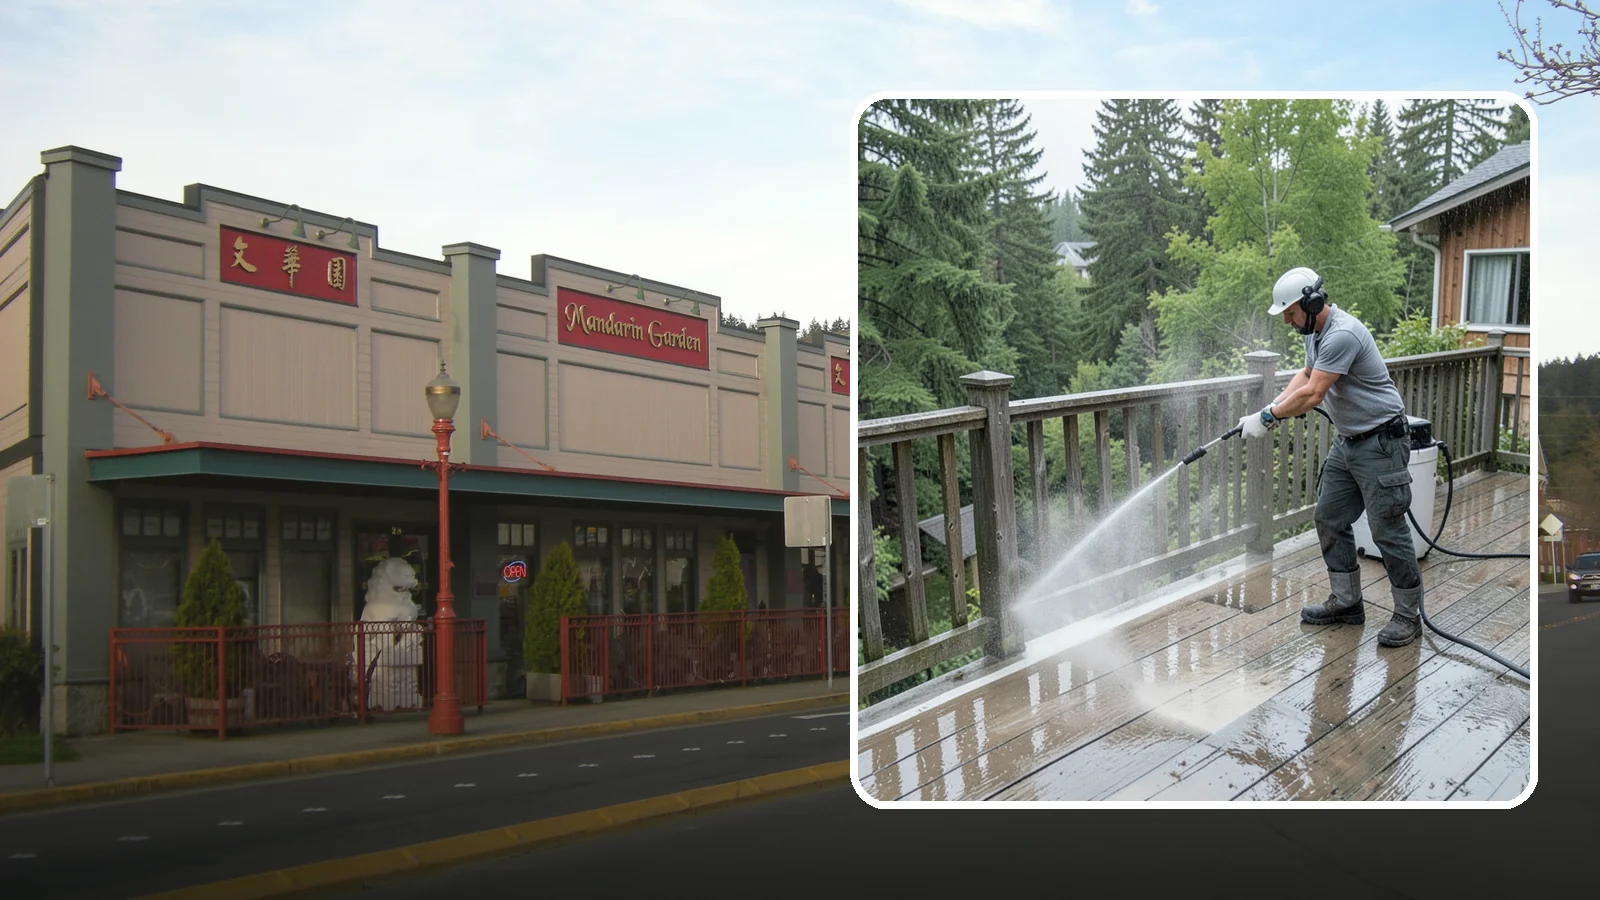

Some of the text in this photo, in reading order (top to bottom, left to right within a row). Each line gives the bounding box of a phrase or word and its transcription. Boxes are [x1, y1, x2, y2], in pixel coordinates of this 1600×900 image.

[231, 236, 346, 291] 文華園
[564, 302, 702, 352] Mandarin Garden
[503, 565, 527, 578] OPEN
